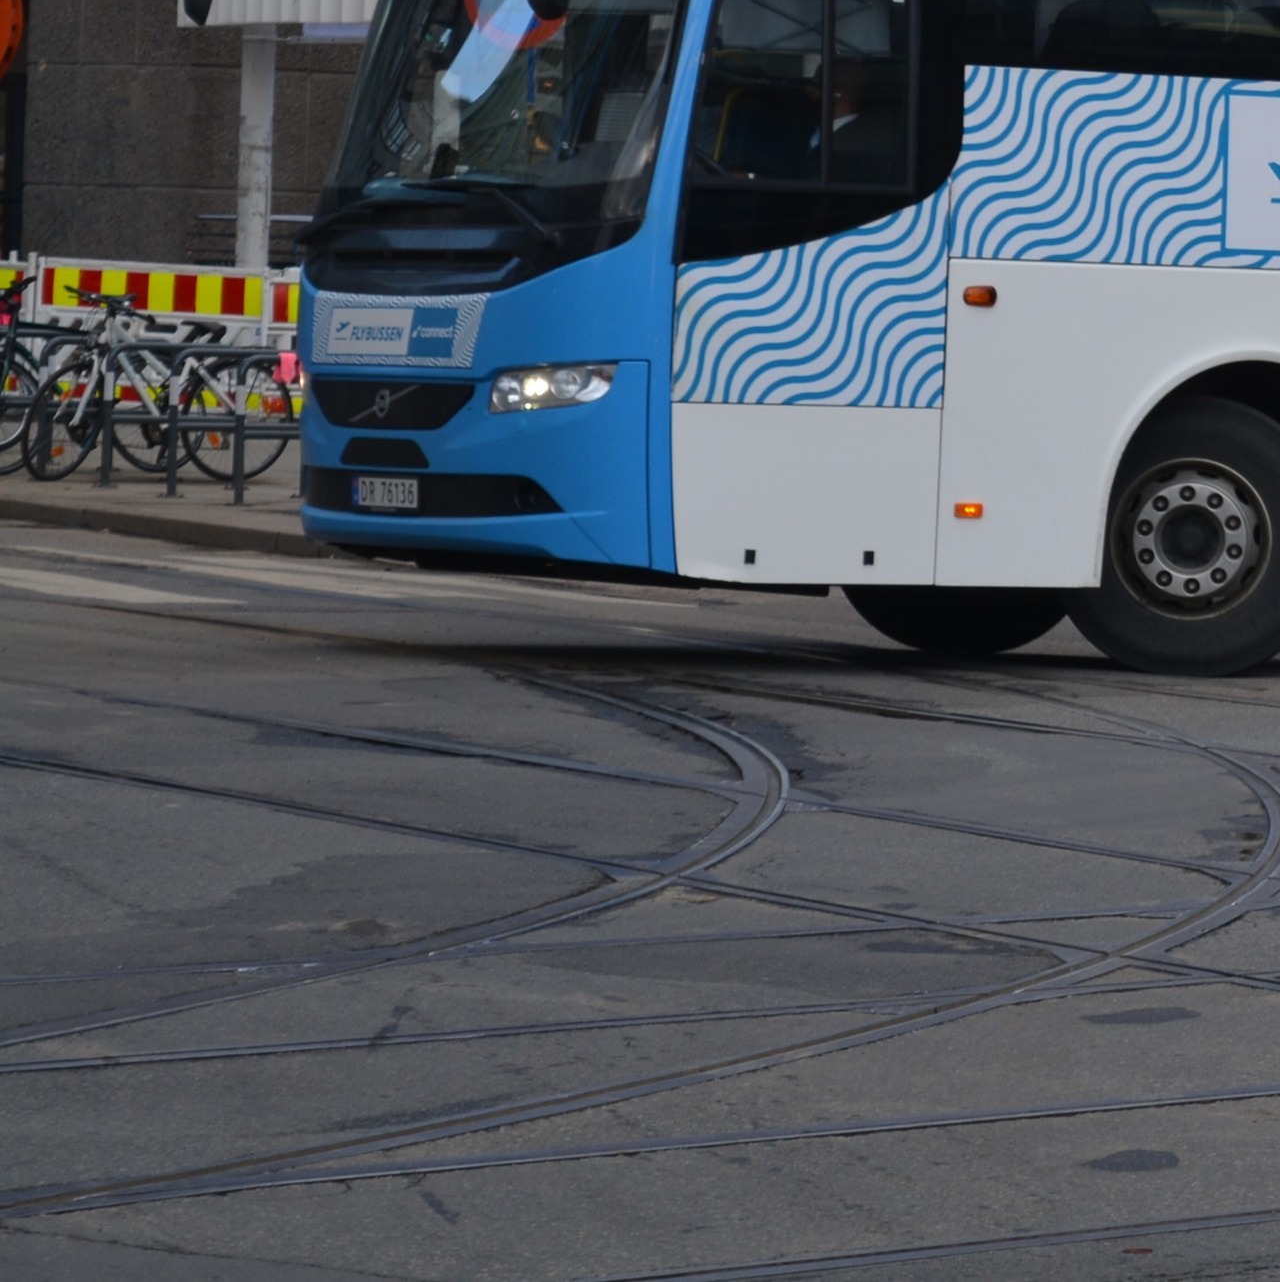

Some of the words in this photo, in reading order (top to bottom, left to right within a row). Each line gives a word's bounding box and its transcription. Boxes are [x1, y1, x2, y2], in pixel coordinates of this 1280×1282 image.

[350, 325, 403, 341] FLYBUSSEN
[420, 325, 453, 338] connect
[361, 480, 375, 502] DR
[381, 481, 415, 505] 76136
